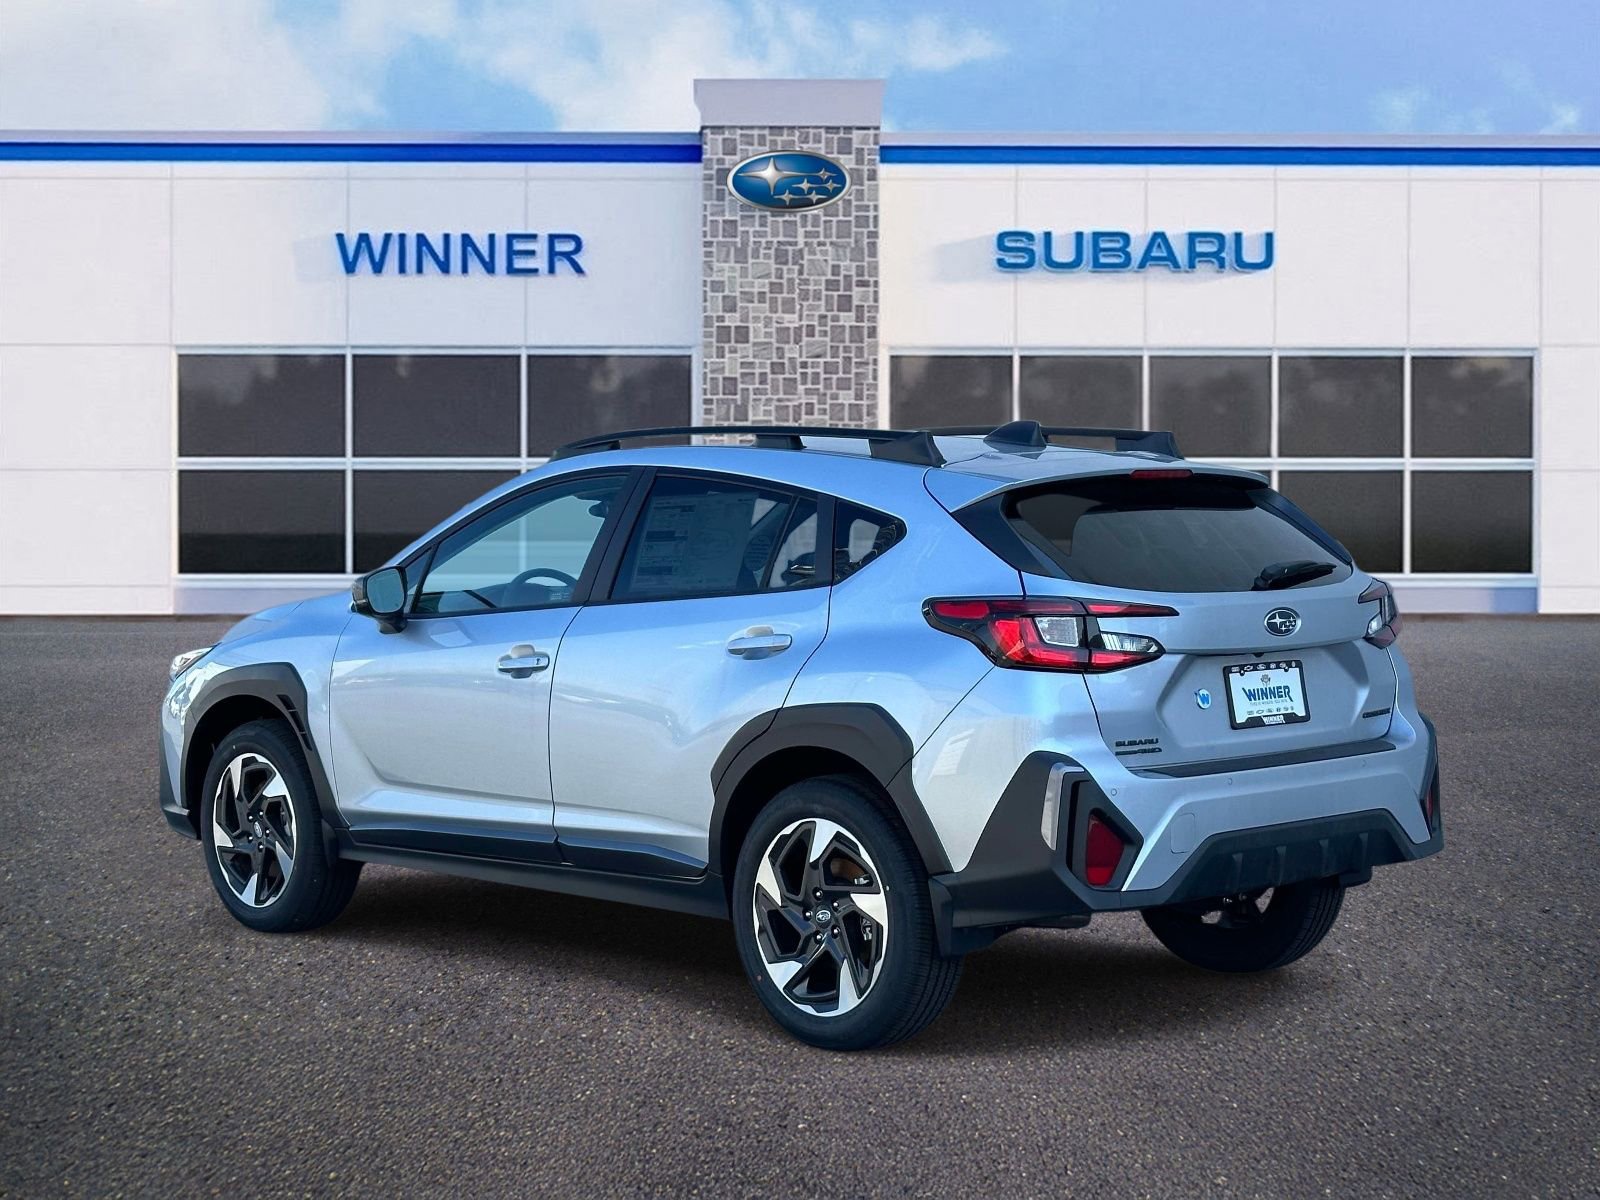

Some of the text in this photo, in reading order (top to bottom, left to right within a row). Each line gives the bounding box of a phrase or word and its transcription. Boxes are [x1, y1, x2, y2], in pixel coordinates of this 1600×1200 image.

[335, 233, 586, 275] WINNER
[996, 231, 1274, 270] SUBARU
[1241, 685, 1294, 702] WINNER
[1115, 737, 1159, 747] SUBARU
